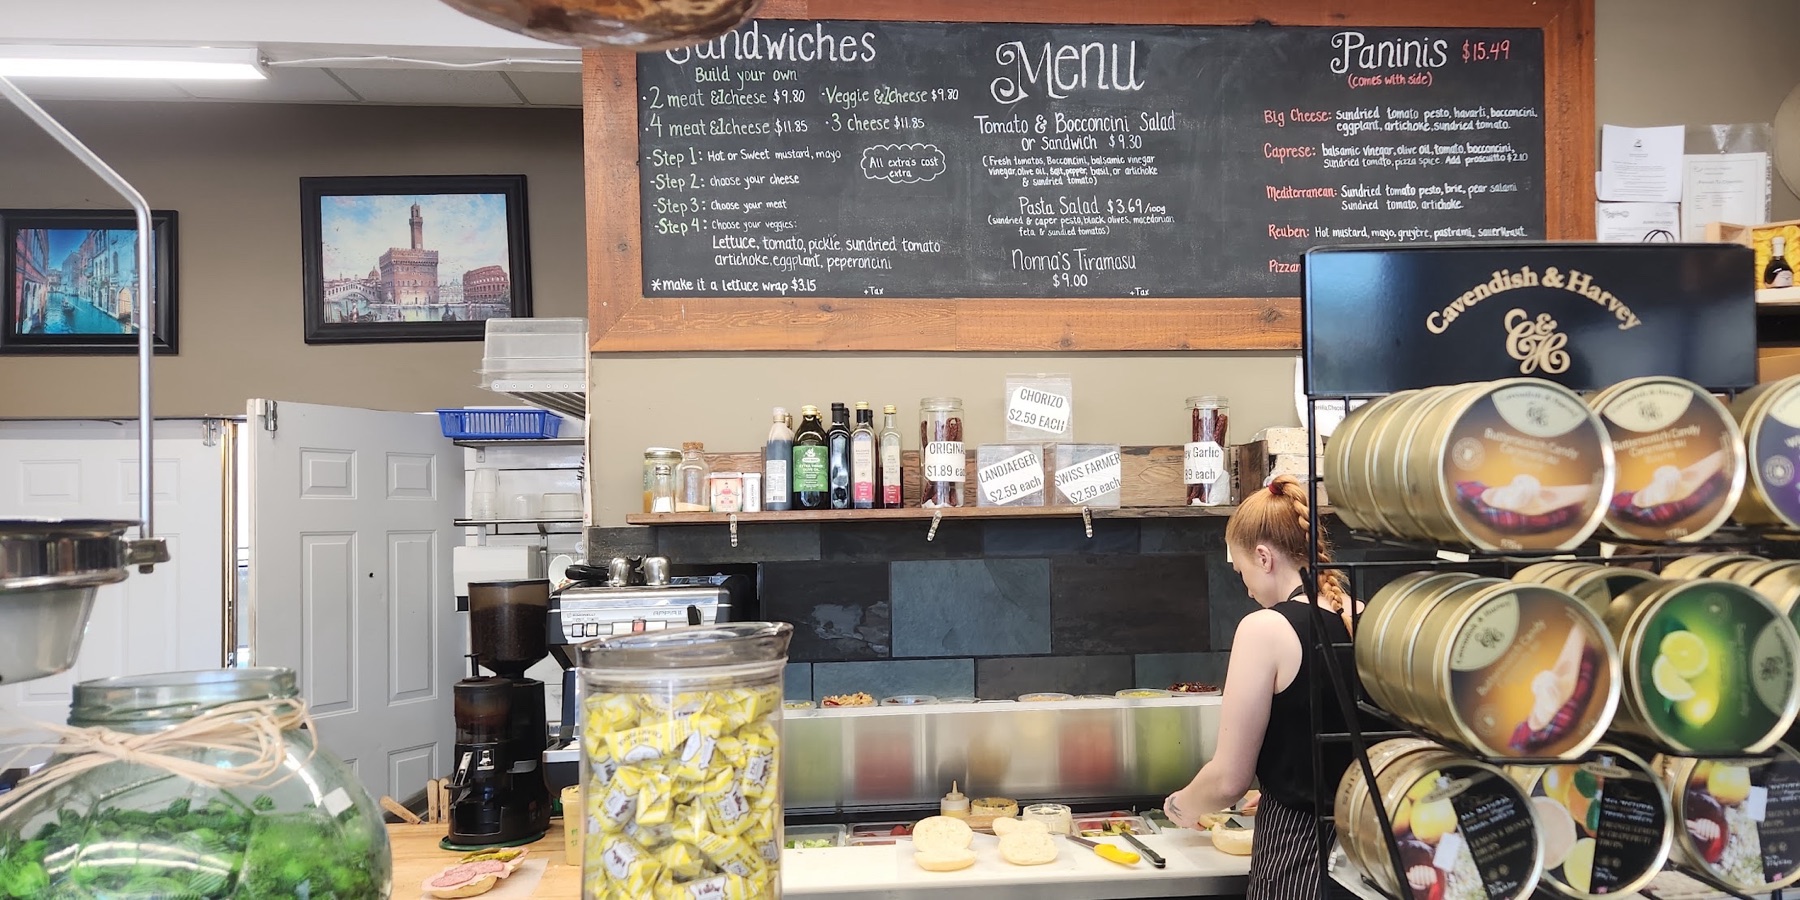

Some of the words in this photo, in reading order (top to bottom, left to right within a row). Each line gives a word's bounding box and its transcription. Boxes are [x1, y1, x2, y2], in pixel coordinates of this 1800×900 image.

[1330, 31, 1448, 74] Paninis
[1461, 39, 1511, 63] $15.49
[695, 65, 730, 82] Build
[737, 70, 766, 90] your
[772, 70, 797, 81] own
[989, 40, 1145, 104] Menu
[1348, 73, 1383, 88] (comes
[1385, 74, 1406, 85] with
[1408, 71, 1433, 87] side)
[649, 86, 664, 109] 2
[667, 89, 705, 107] meat
[772, 89, 805, 104] $9.80
[826, 85, 869, 110] Veggie
[931, 88, 959, 102] $9.80
[650, 113, 662, 137] 4
[669, 121, 706, 136] meat
[774, 118, 808, 137] $11.85
[831, 112, 841, 131] 3
[847, 113, 890, 131] cheese
[894, 115, 925, 130] $11.85
[973, 113, 1029, 134] Tomato
[1034, 114, 1047, 133] &
[1055, 112, 1130, 134] Bocconcini
[1139, 110, 1176, 132] Salad
[1264, 110, 1285, 128] Big
[1290, 108, 1332, 122] Cheese:
[1387, 107, 1419, 119] tomato
[1424, 108, 1452, 122] pesto,
[1021, 137, 1036, 151] or
[708, 150, 725, 162] Hot
[728, 151, 738, 160] or
[741, 149, 770, 160] Sweet
[775, 147, 814, 161] mustard,
[815, 150, 841, 162] mayo
[870, 156, 883, 169] All
[888, 157, 916, 167] extra's
[921, 156, 939, 166] cost
[1091, 155, 1125, 165] balsamic
[1127, 155, 1155, 167] vinegar
[1264, 143, 1316, 164] Caprese:
[1321, 143, 1361, 157] balsamic
[1396, 145, 1417, 155] olive
[1395, 158, 1417, 170] pizza
[1445, 155, 1461, 165] Add
[1506, 152, 1528, 163] $2.10
[889, 169, 912, 178] extra
[1091, 166, 1112, 177] basil,
[1112, 167, 1121, 175] or
[1125, 165, 1158, 176] artichoke
[710, 175, 741, 187] choose
[744, 175, 765, 190] your
[769, 173, 799, 185] cheese
[1022, 178, 1029, 187] &
[1033, 177, 1063, 186] sundried
[1266, 185, 1338, 201] Mediterranean:
[1340, 183, 1382, 198] Sundried
[1385, 184, 1416, 196] tomato
[1419, 185, 1444, 199] pesto,
[1444, 182, 1466, 194] brie,
[1467, 184, 1487, 199] pear
[743, 200, 763, 214] your
[766, 199, 787, 209] meat
[1018, 197, 1055, 215] Pasta
[1060, 196, 1100, 215] Salad
[1386, 199, 1419, 210] tomato,
[743, 221, 761, 232] your
[765, 219, 797, 232] veggies:
[1026, 217, 1033, 225] &
[1035, 216, 1057, 228] caper
[1083, 215, 1106, 224] black
[1018, 227, 1036, 237] feta
[1039, 228, 1045, 236] &
[1268, 224, 1310, 239] Reuben:
[1315, 226, 1330, 238] Hot
[1332, 226, 1370, 239] mustard,
[1371, 230, 1397, 241] mayo,
[712, 235, 760, 250] Lettuce,
[762, 235, 806, 253] tomato,
[846, 236, 897, 252] sundried
[901, 237, 941, 253] tomato
[826, 257, 892, 272] peperoncini
[663, 278, 693, 291] make
[697, 278, 705, 291] it
[710, 282, 718, 290] a
[722, 279, 759, 291] lettuce
[762, 280, 788, 296] wrap
[790, 277, 816, 292] $3.15
[1425, 265, 1539, 334] Cavendish
[1541, 266, 1565, 288] &
[1565, 269, 1642, 331] Harvey
[1019, 388, 1064, 409] CHORIZO
[1008, 408, 1037, 426] $2.59
[1038, 415, 1066, 433] EACH
[1193, 446, 1219, 458] Garlic
[927, 465, 953, 477] $1.89
[978, 453, 1037, 483] LANDJAEGER
[1054, 468, 1083, 487] SWISS
[1084, 453, 1121, 476] FARMER
[1195, 468, 1216, 480] each
[989, 485, 1017, 503] $2.59
[1018, 475, 1042, 493] each
[1070, 486, 1098, 504] $2.59
[1100, 475, 1121, 495] each
